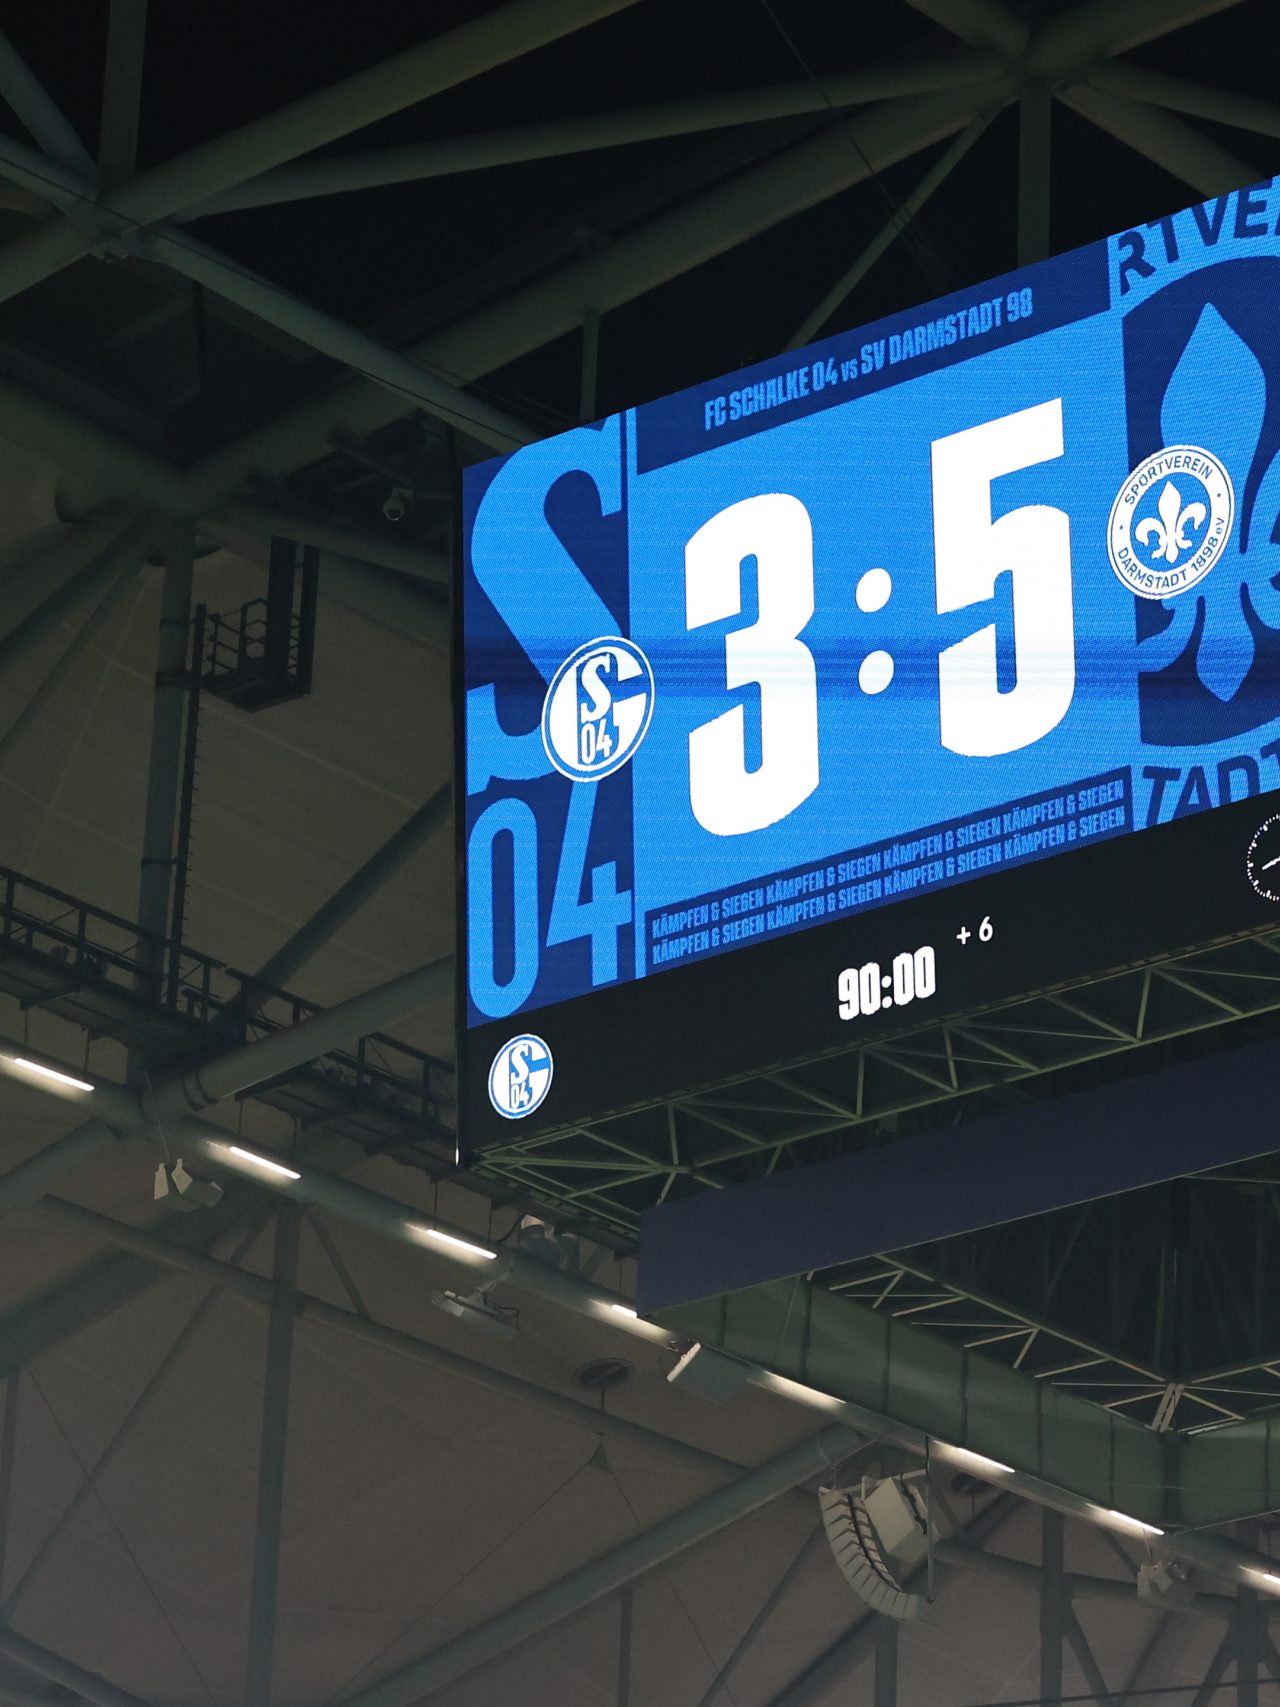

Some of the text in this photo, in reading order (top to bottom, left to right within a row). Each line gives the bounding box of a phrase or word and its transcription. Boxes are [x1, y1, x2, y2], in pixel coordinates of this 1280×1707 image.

[704, 396, 727, 431] FC
[729, 366, 810, 422] SCHALKE
[812, 357, 838, 391] 04
[860, 340, 886, 375] SV
[889, 296, 1003, 365] DARMSTADT
[1006, 287, 1033, 323] 98
[1125, 455, 1213, 505] SPORTVEREIN
[1118, 547, 1188, 590] DARMSTADT
[1191, 536, 1219, 572] 1898
[652, 905, 709, 939] KÄMPFEN
[722, 888, 764, 920] SIEGEN
[766, 868, 824, 904] KÄMPFEN
[838, 852, 882, 882] SIEGEN
[884, 834, 942, 870] KÄMPFEN
[956, 816, 1000, 848] SIEGEN
[1003, 797, 1064, 834] KÄMPFEN
[1078, 779, 1124, 811] SIEGEN
[652, 931, 710, 964] KÄMPFEN
[722, 914, 764, 944] SIEGEN
[768, 896, 824, 930] KÄMPFEN
[838, 878, 882, 909] SIEGEN
[884, 860, 944, 896] KÄMPFEN
[957, 842, 1000, 874] SIEGEN
[1004, 823, 1064, 860] KÄMPFEN
[1079, 806, 1125, 837] SIEGEN
[838, 945, 936, 1021] 90:00
